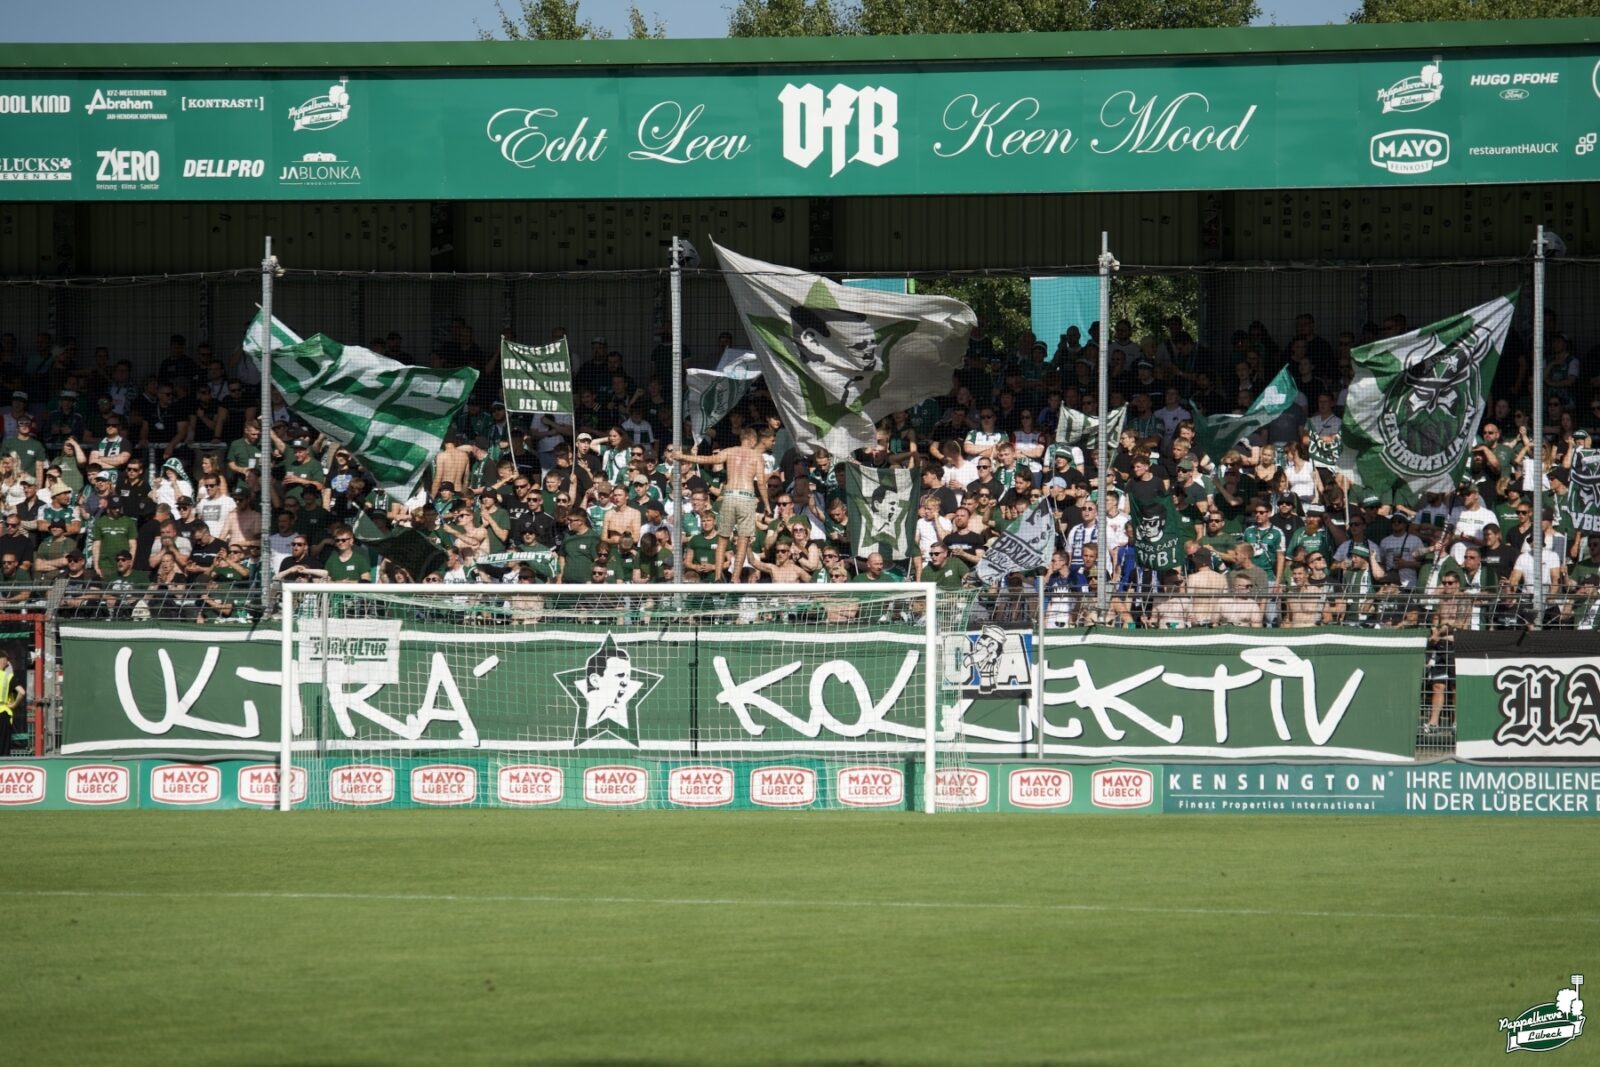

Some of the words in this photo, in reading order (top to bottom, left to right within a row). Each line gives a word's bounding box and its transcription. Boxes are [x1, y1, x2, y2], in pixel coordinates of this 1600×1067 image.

[1470, 74, 1511, 86] HUGO
[1513, 72, 1559, 84] PFOHE
[31, 95, 71, 114] KIND
[84, 88, 153, 115] Abraham
[933, 93, 1079, 157] Keen
[1090, 90, 1258, 154] Mood
[486, 107, 608, 169] Echt
[628, 100, 751, 164] Leev
[1378, 138, 1443, 158] MAYO
[1469, 143, 1559, 155] restaurantHAUCK
[0, 157, 60, 171] LÜCKS
[183, 159, 265, 177] DELLPRO
[1390, 162, 1430, 172] FEINKOST
[279, 166, 361, 180] JABLONKA
[519, 398, 538, 410] DER
[77, 771, 119, 783] MAYO
[162, 771, 209, 783] MAYO
[341, 771, 383, 783] MAYO
[422, 771, 465, 783] MAYO
[509, 772, 552, 783] MAYO
[594, 772, 637, 783] MAYO
[680, 772, 723, 784] MAYO
[761, 773, 805, 784] MAYO
[848, 773, 892, 785] MAYO
[935, 774, 978, 785] MAYO
[1020, 775, 1062, 786] MAYO
[1102, 775, 1143, 787] MAYO
[1169, 773, 1385, 791] KENSINGTON
[1406, 771, 1453, 789] IHRE
[1460, 772, 1600, 790] IMMOBILIENE
[77, 784, 118, 794] LÜBECK
[162, 783, 208, 794] LÜBECK
[250, 783, 294, 794] LÜBEK
[341, 783, 383, 794] LÜBECK
[422, 783, 464, 794] LÜBECK
[509, 783, 551, 794] LÜBECK
[594, 784, 636, 794] LÜBECK
[680, 785, 722, 795] LÜBECK
[761, 785, 804, 795] LÜBECK
[848, 785, 892, 795] LÜBECK
[935, 786, 977, 796] LÜBECK
[1020, 787, 1061, 797] LÜBECK
[1102, 787, 1142, 797] LÜBECK
[1178, 800, 1215, 810] Finest
[1222, 800, 1285, 811] Properties
[1291, 801, 1376, 811] International
[1406, 792, 1427, 810] IN
[1434, 793, 1475, 811] DER
[1482, 790, 1589, 811] LÜBECKER
